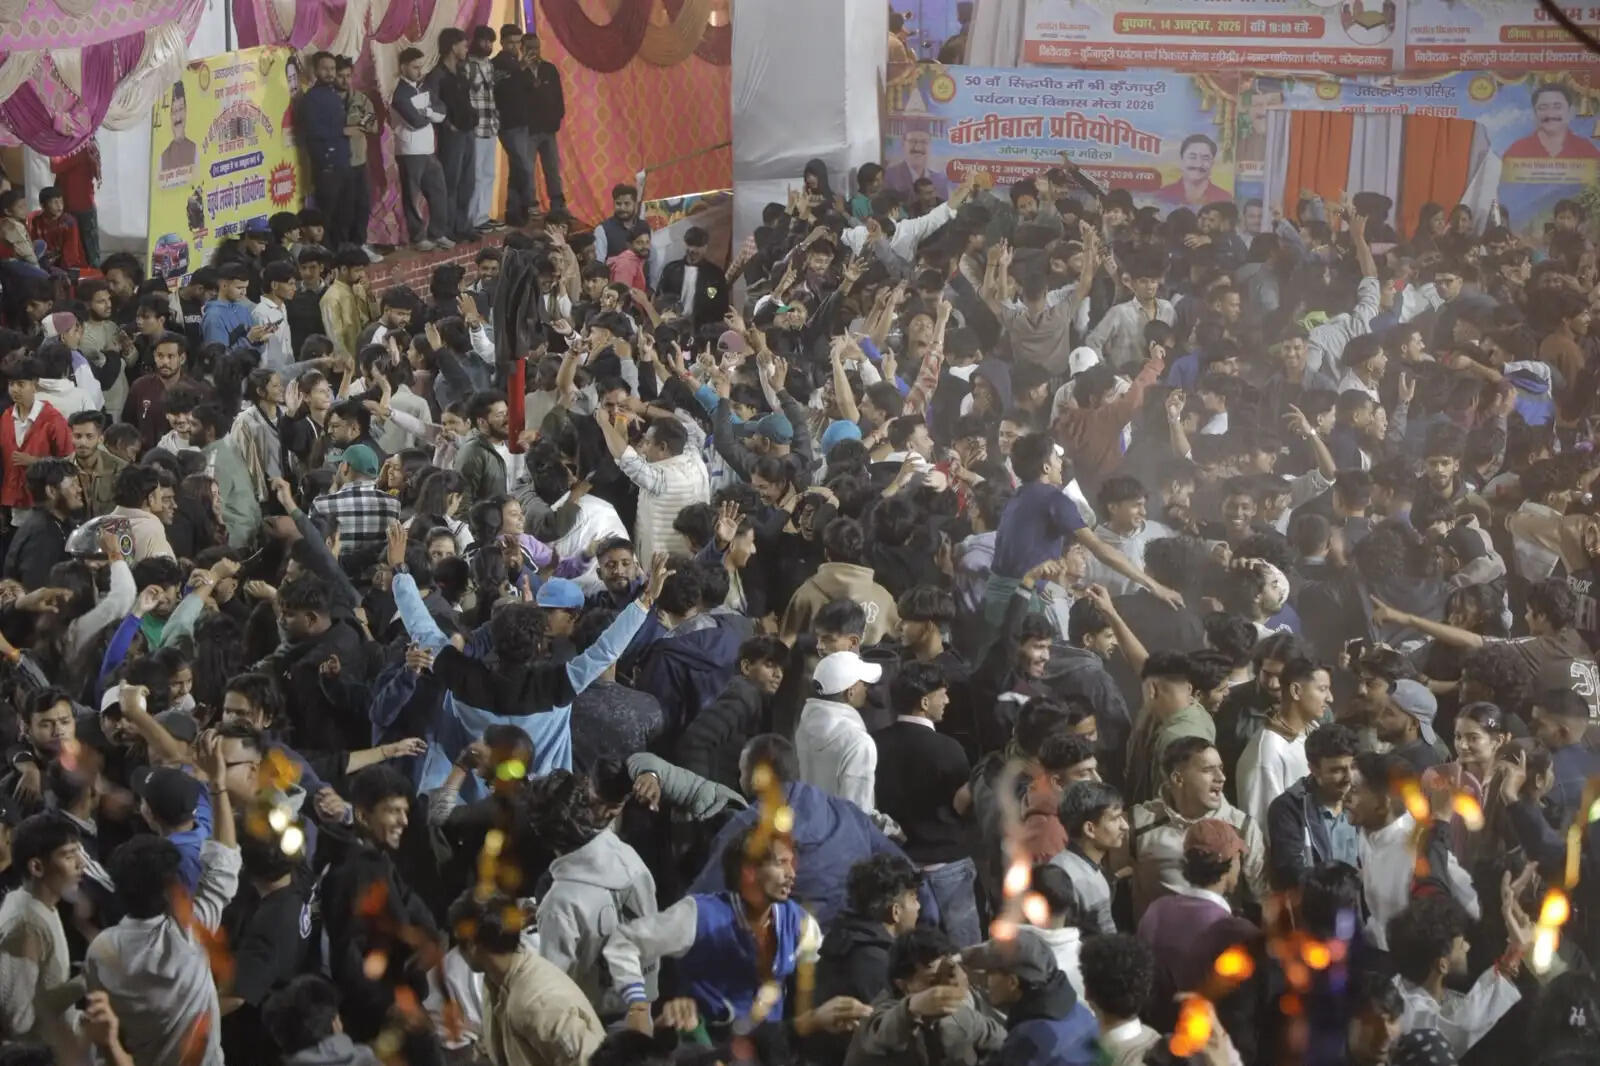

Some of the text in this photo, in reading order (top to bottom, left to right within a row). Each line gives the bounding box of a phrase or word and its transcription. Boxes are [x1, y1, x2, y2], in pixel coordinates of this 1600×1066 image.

[965, 76, 981, 86] 50
[1087, 79, 1105, 91] श्री
[974, 93, 1154, 110] पर्यटन एवं विकास मेला 2026
[949, 111, 1162, 154] बॉलीबाल प्रतियोगिता
